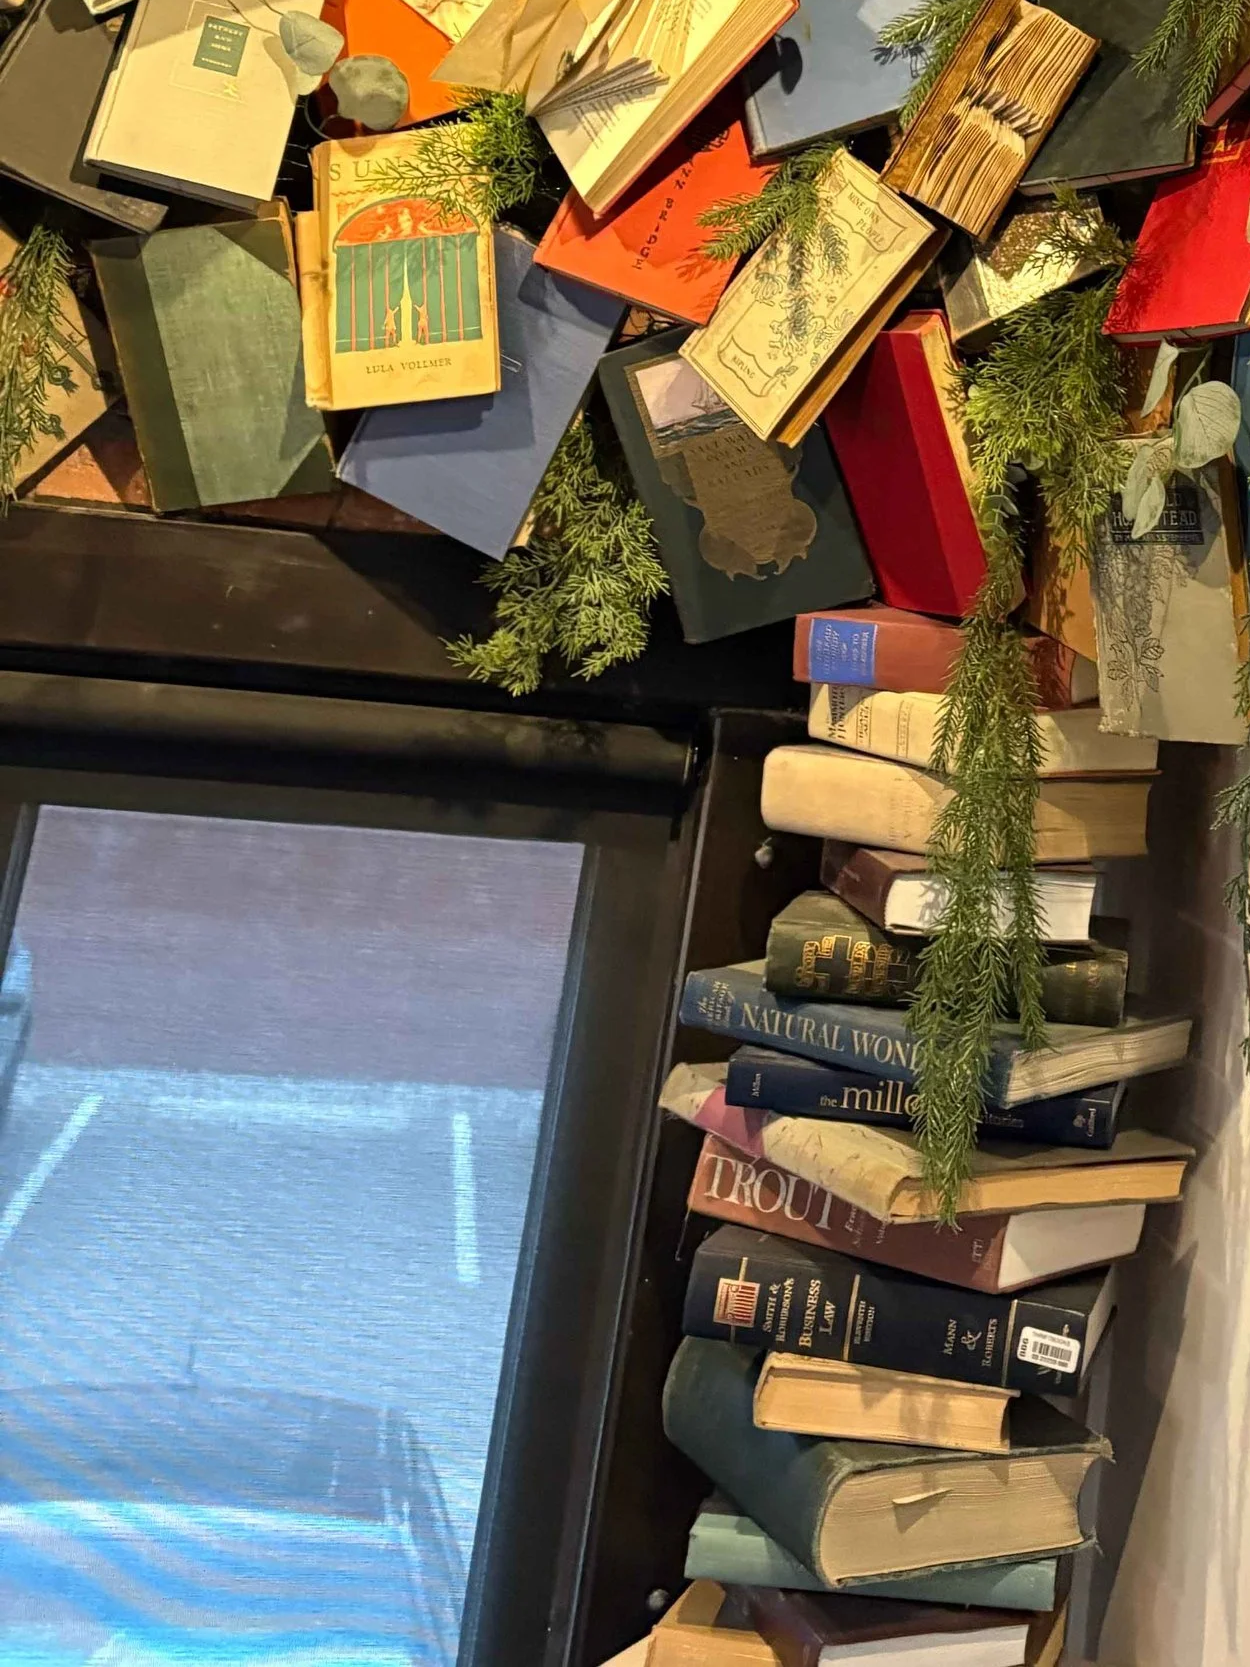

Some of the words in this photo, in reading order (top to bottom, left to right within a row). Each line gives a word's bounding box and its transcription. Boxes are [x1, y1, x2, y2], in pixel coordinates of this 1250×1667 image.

[632, 198, 674, 270] BRIDGE
[856, 218, 885, 246] PEOPLE
[365, 363, 395, 375] LULA
[400, 357, 451, 372] VOLLMER
[731, 355, 756, 379] KIPLING
[741, 1002, 844, 1052] NATURAL
[819, 1095, 838, 1108] the
[703, 1152, 837, 1230] TROUT
[768, 1281, 782, 1296] &
[762, 1297, 777, 1333] SMITH
[798, 1279, 822, 1348] BUSINESS
[818, 1300, 834, 1335] LAW
[943, 1319, 958, 1356] MANN
[960, 1327, 982, 1352] &
[981, 1318, 999, 1368] ROBERTS
